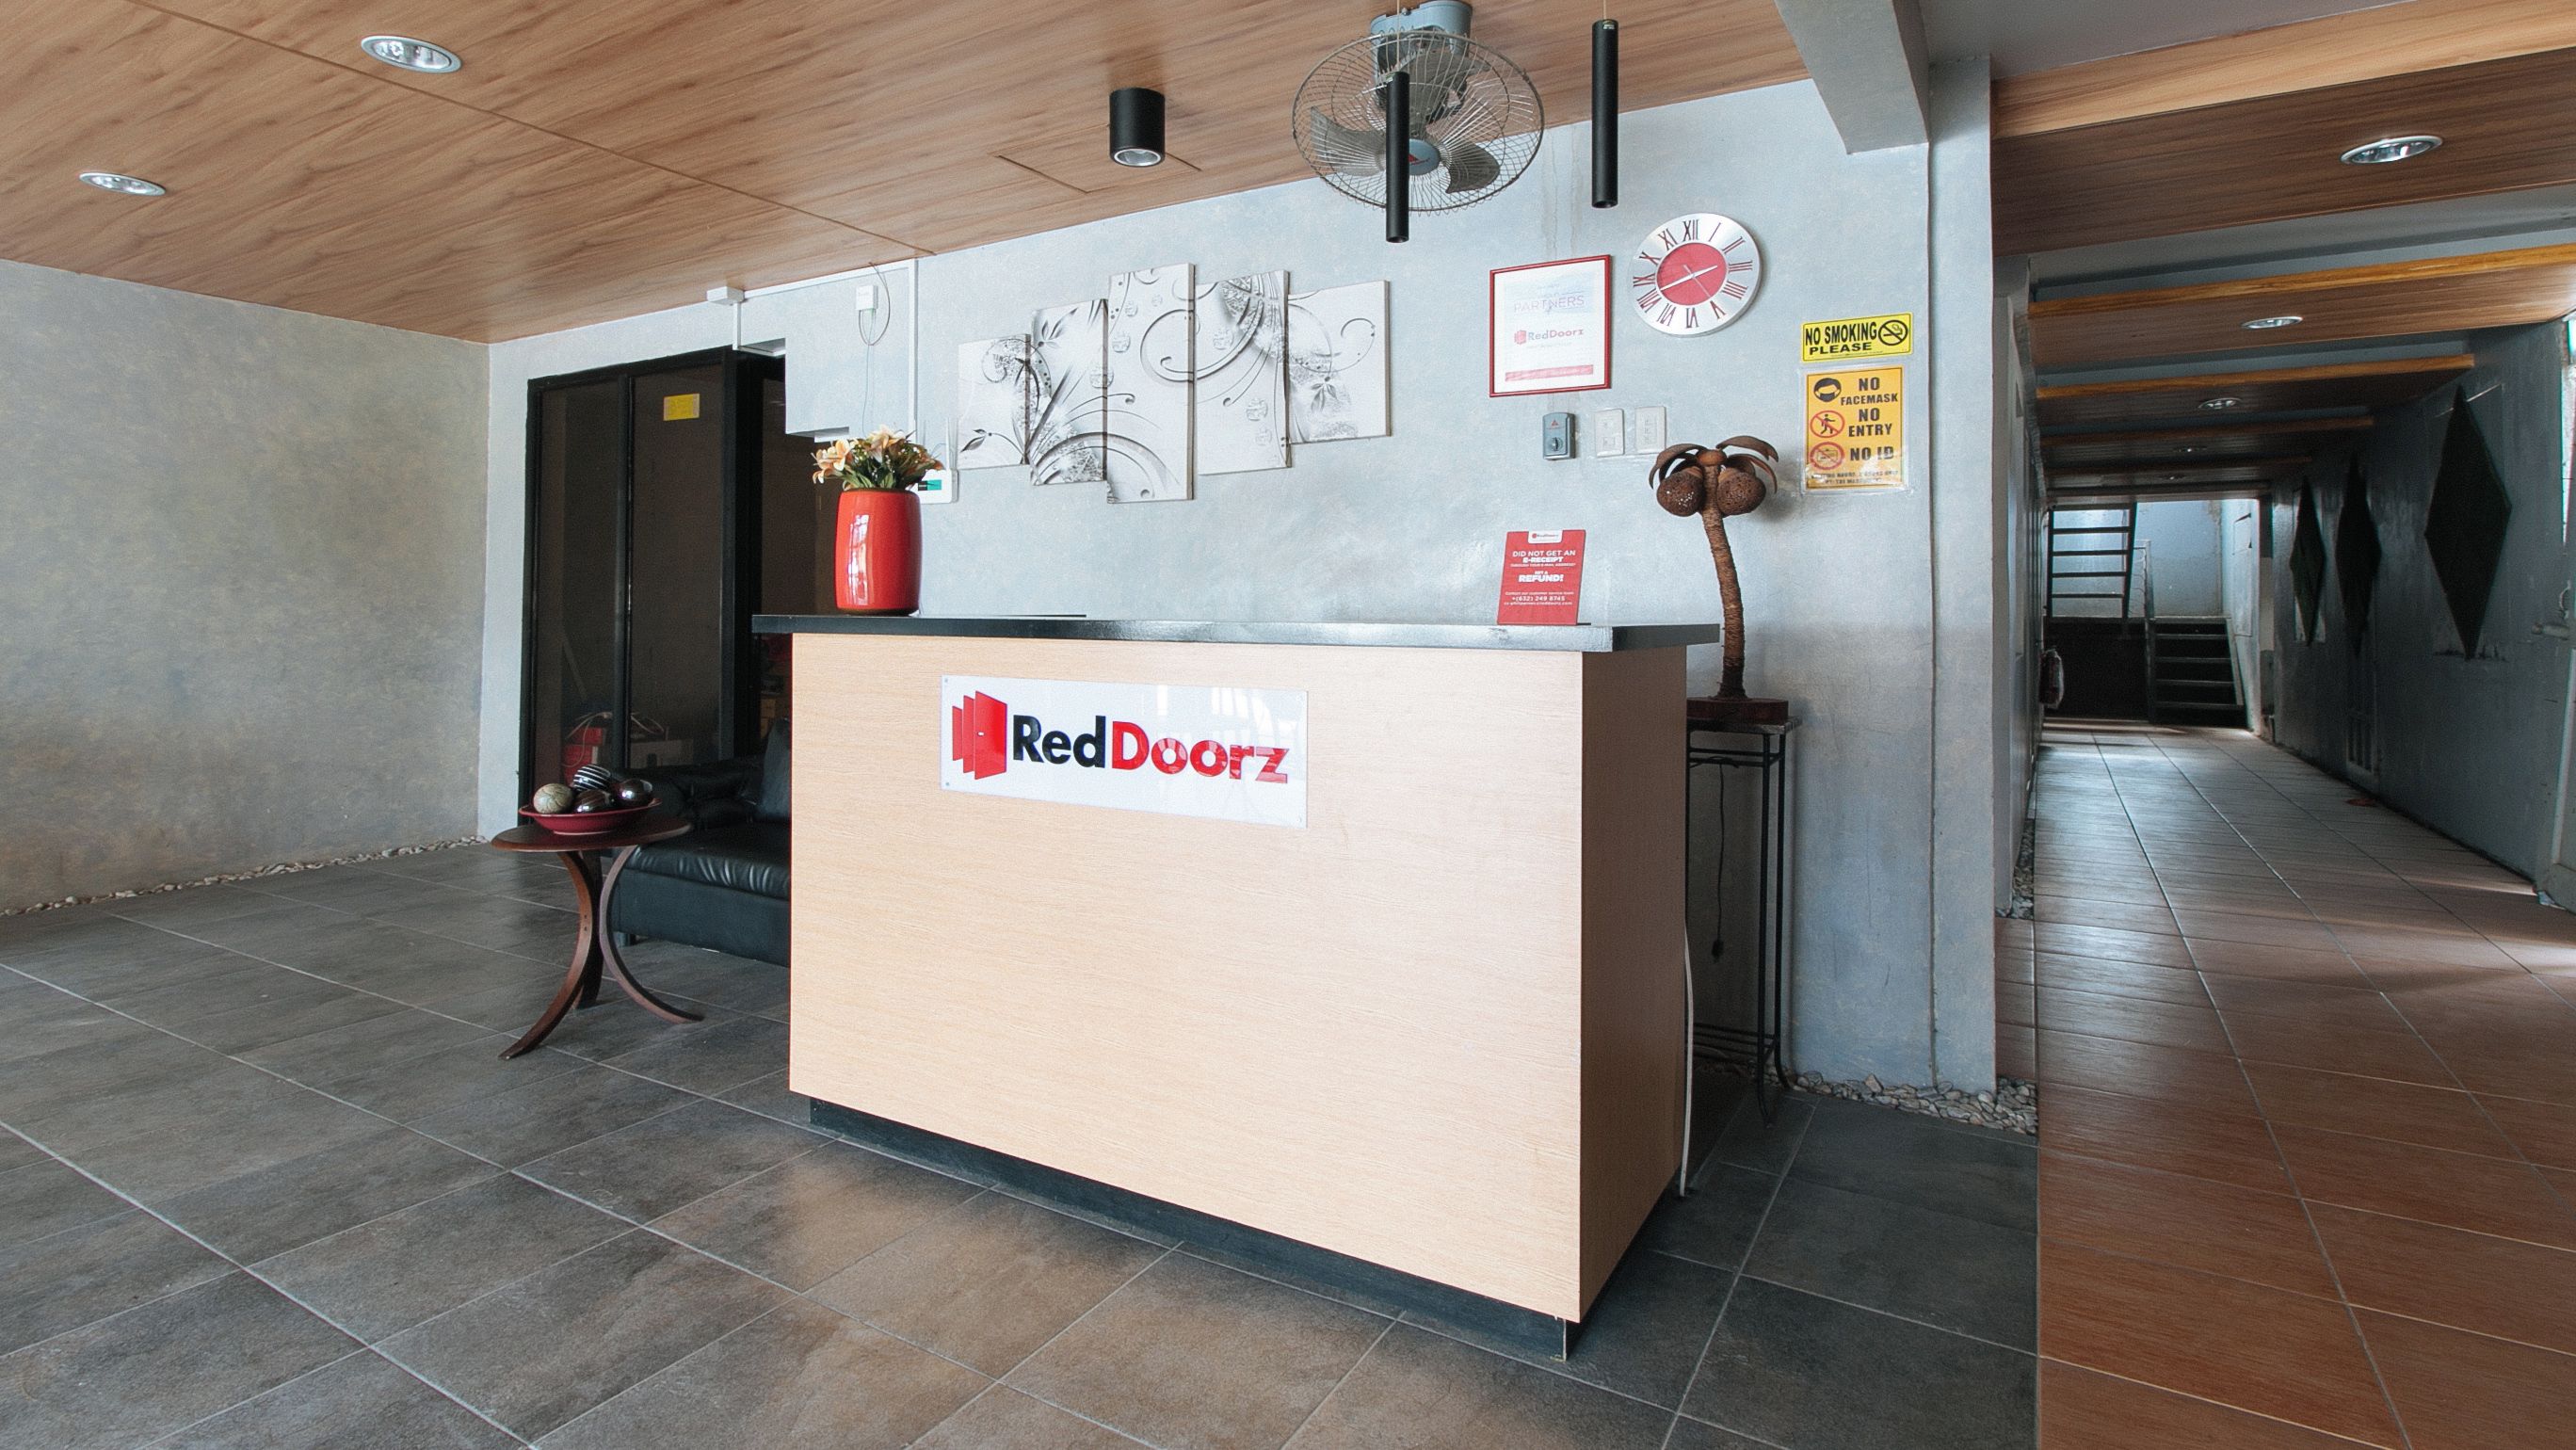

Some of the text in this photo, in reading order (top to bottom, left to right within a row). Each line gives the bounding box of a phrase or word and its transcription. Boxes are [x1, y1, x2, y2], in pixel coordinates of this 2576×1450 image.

[1682, 219, 1699, 242] XII
[1658, 228, 1679, 250] XI
[1722, 236, 1746, 254] II
[1639, 251, 1662, 266] X
[1729, 260, 1753, 273] III
[1721, 281, 1748, 300] IIII
[1514, 295, 1585, 314] PARTNERS
[1710, 300, 1726, 320] V
[1685, 307, 1699, 329] VI
[1527, 329, 1584, 341] RedDoorz
[1805, 321, 1877, 346] NO SMOKING
[1809, 342, 1872, 355] PLEASE
[1858, 377, 1880, 392] NO
[1841, 393, 1898, 406] FACEMASK
[1858, 408, 1880, 422] NO
[1848, 423, 1892, 438] ENTRY
[1850, 446, 1894, 460] NO ID
[1518, 573, 1564, 582] REFUND!
[1012, 715, 1290, 784] RedDoorz
